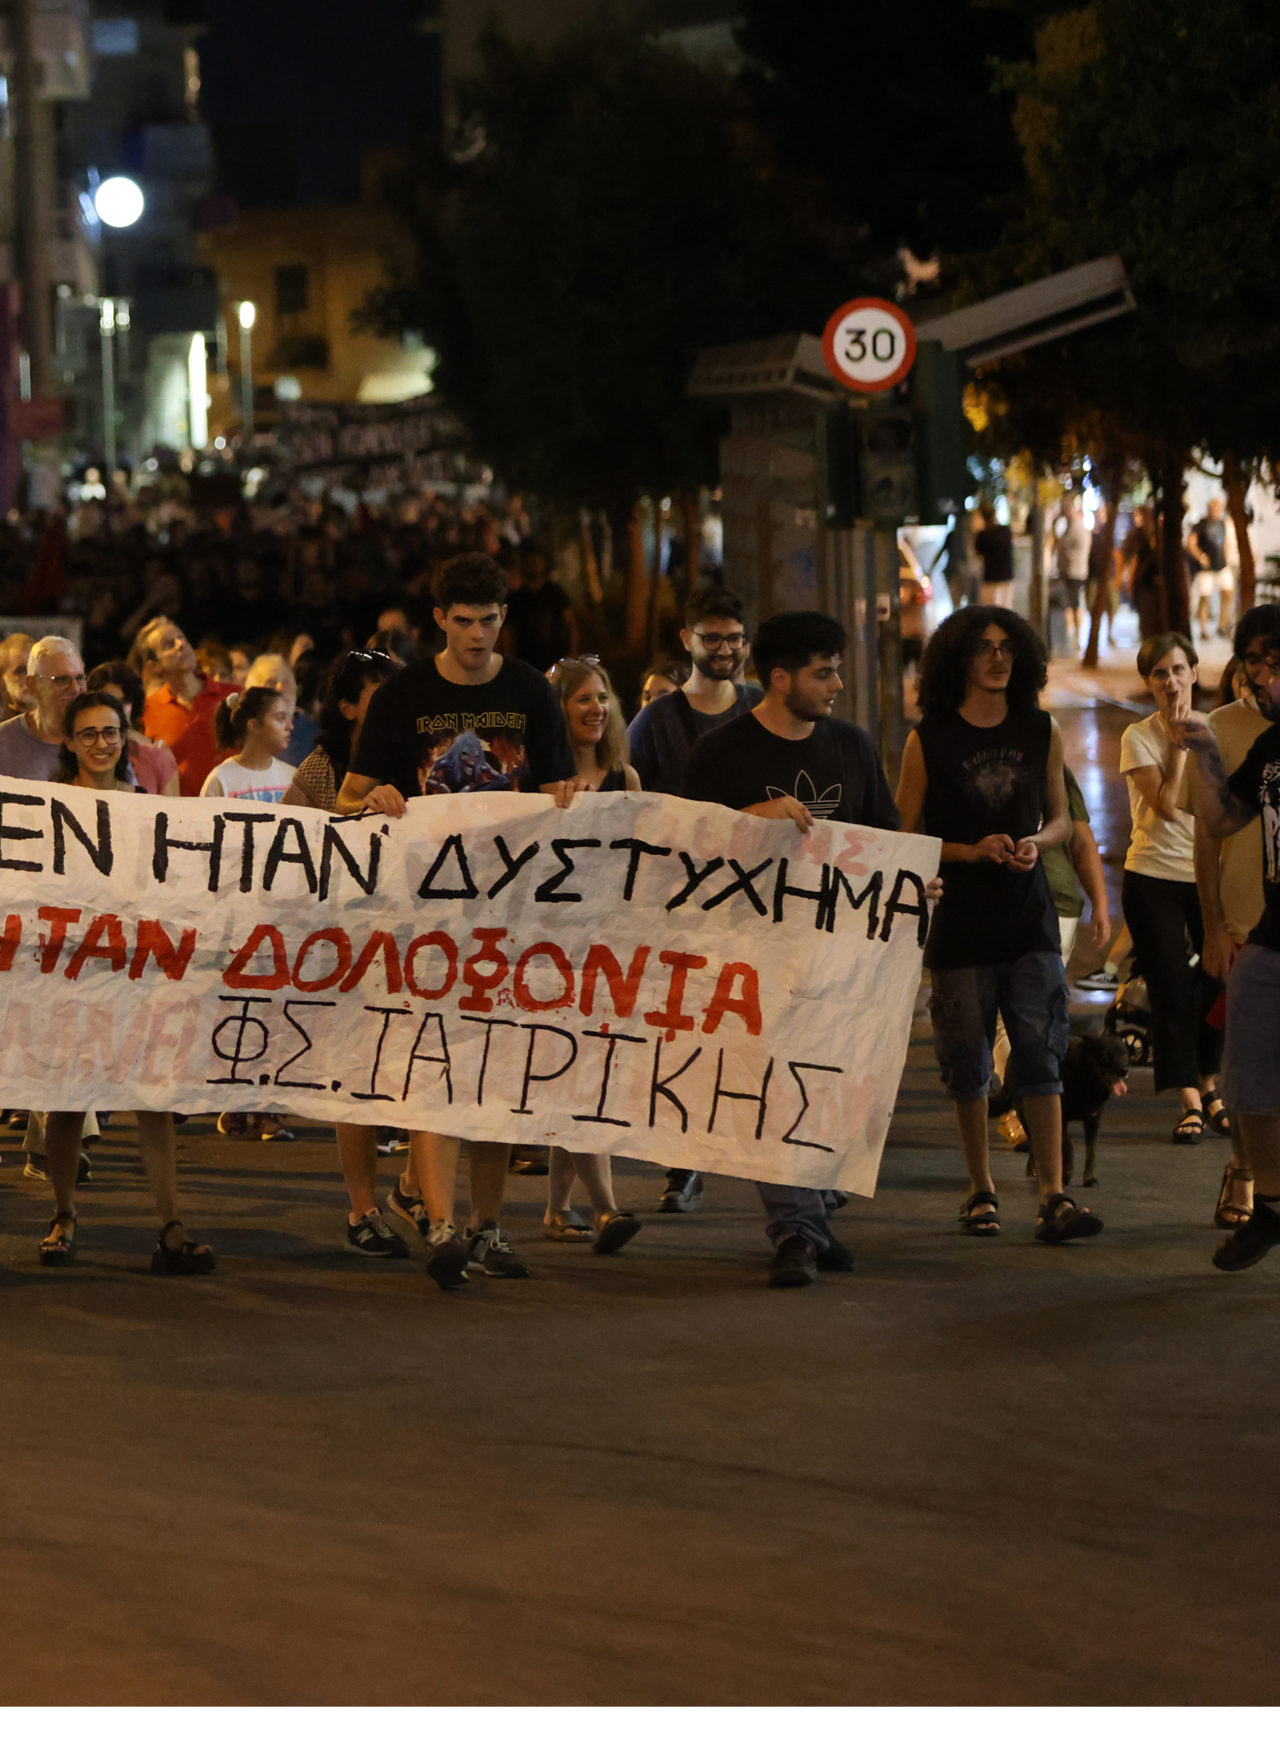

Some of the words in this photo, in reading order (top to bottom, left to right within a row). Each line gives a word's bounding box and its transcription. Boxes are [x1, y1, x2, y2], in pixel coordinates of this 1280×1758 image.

[845, 328, 895, 362] 30
[416, 713, 458, 735] IRON
[461, 711, 527, 736] MAIDEN
[153, 812, 388, 902] ΗΤΑΝ
[417, 836, 927, 950] ΔΥΣΤΥΧΗΜΑ
[223, 925, 763, 1037] ΔΟΛΟΦΟΝΙΑ
[351, 1006, 844, 1153] ΙΑΤΡΙΚΗΣ
